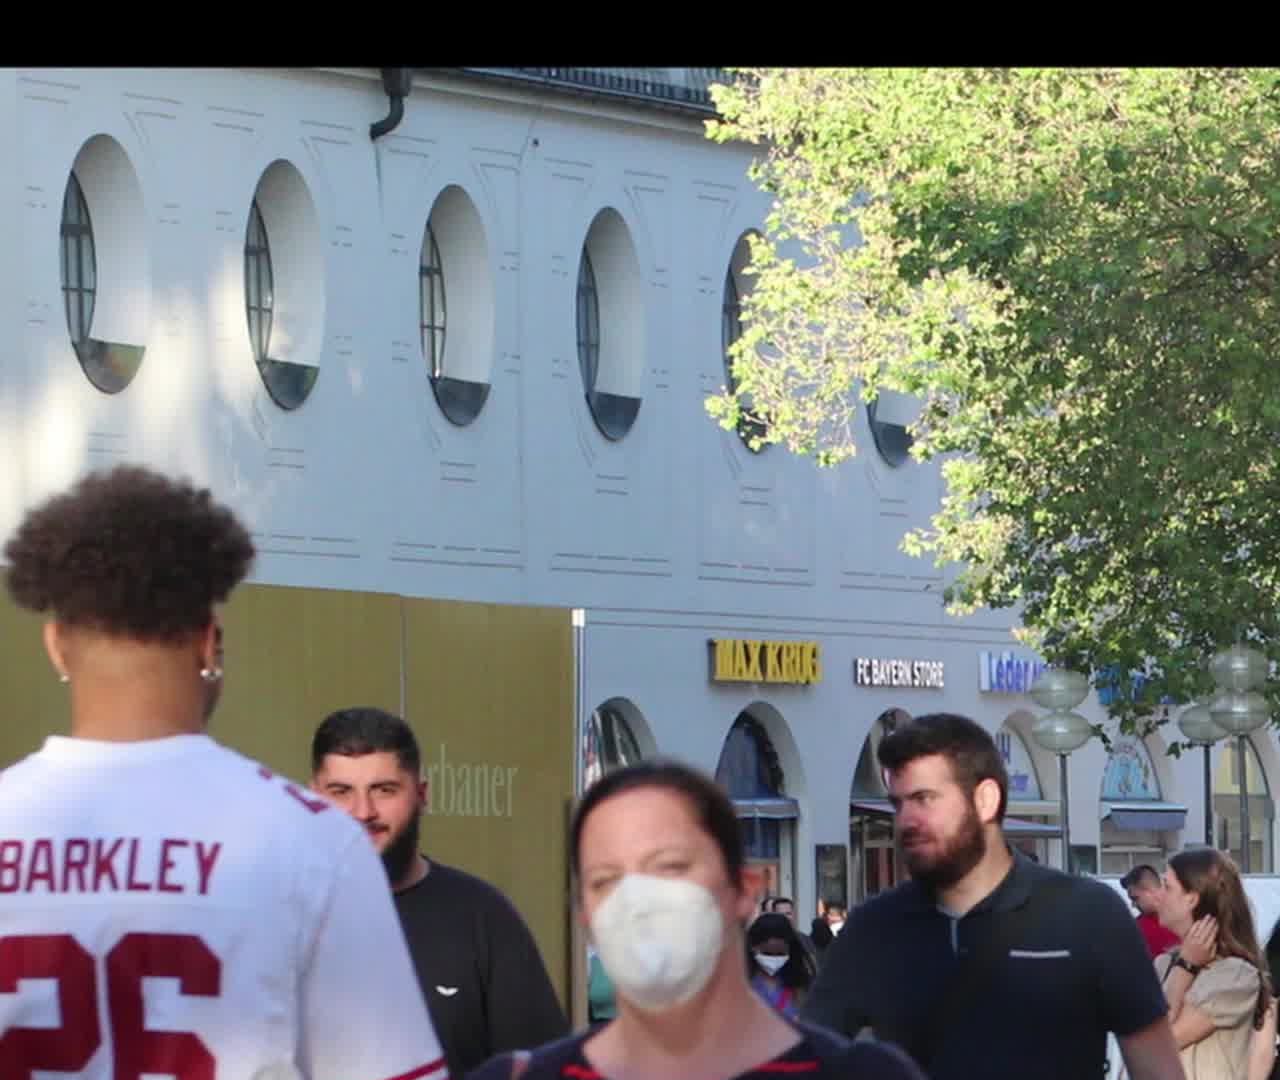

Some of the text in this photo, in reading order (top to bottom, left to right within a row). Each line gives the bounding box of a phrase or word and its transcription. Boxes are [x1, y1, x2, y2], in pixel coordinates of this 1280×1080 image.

[714, 639, 822, 684] MAX KRUG
[856, 657, 945, 688] FC BAYERN STORE
[0, 839, 222, 896] BARKLEY
